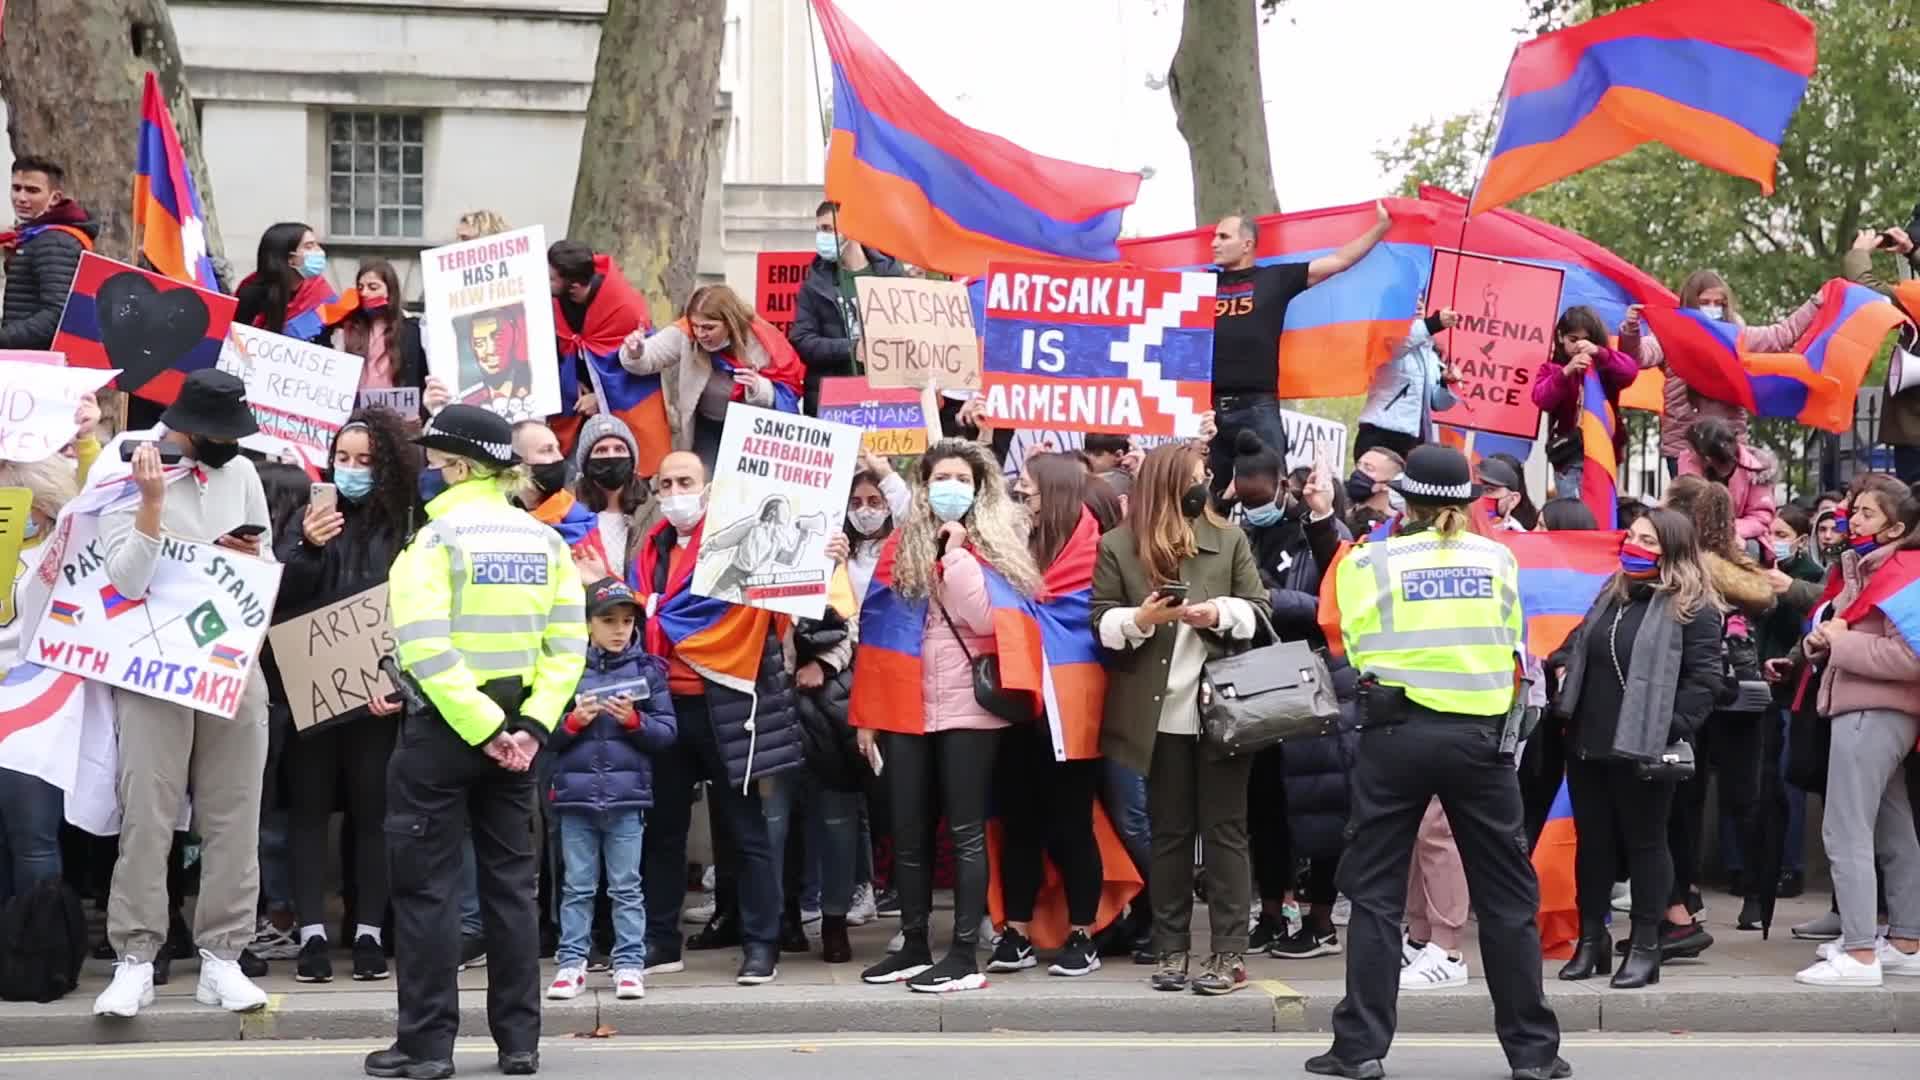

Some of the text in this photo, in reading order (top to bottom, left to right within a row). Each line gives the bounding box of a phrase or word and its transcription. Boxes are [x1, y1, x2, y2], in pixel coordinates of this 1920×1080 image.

[436, 236, 529, 273] TERRORISM
[463, 260, 509, 287] HAS A
[864, 287, 973, 329] ARTSAKH
[986, 271, 1145, 318] ARTSAKH
[871, 339, 961, 374] STRONG
[1020, 329, 1067, 373] IS
[1455, 358, 1529, 385] ANTS
[266, 371, 354, 413] REPUBLIC
[986, 384, 1143, 428] ARMENIA
[824, 406, 920, 424] ARMENIANS
[753, 417, 832, 448] SANCTION
[742, 436, 835, 469] AZERBAIJAN
[737, 457, 833, 489] AND TURKEY
[472, 553, 547, 564] METROPOLITAN
[473, 563, 547, 583] POLICE
[1402, 567, 1493, 581] METROPOLITAN
[203, 555, 266, 629] STAND
[1403, 578, 1493, 600] POLICE
[371, 630, 397, 658] IS
[39, 637, 243, 719] WITH ARTSAKH
